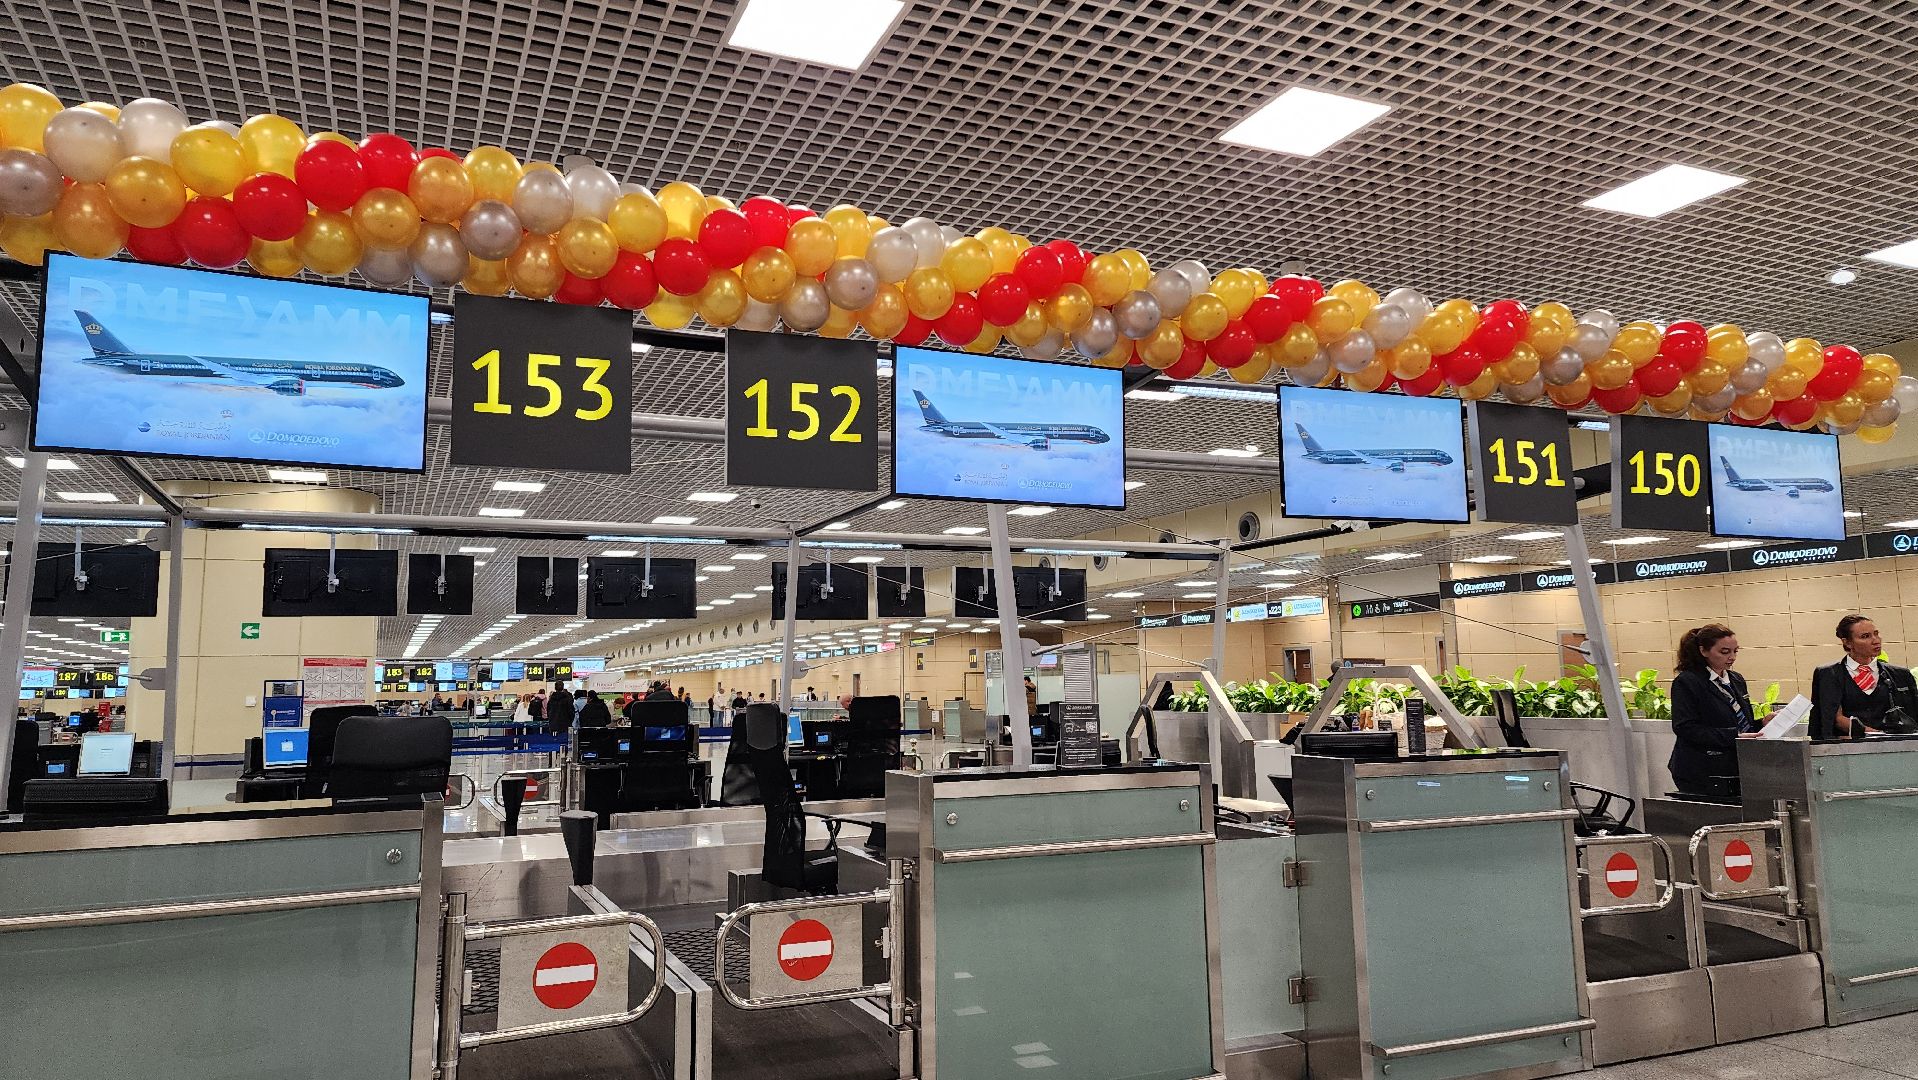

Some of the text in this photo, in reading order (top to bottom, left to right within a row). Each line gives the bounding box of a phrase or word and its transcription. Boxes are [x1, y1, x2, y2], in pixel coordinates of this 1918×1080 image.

[471, 349, 614, 421] 153
[743, 379, 862, 443] 152
[266, 431, 340, 446] DOMODEDOVO
[1488, 438, 1566, 487] 151
[1628, 450, 1701, 497] 150
[1769, 546, 1838, 561] DOMODEDOVO
[1649, 560, 1707, 573] DOMODEDOVO
[1463, 580, 1506, 592] DOMODEDOVO
[58, 672, 78, 681] 187
